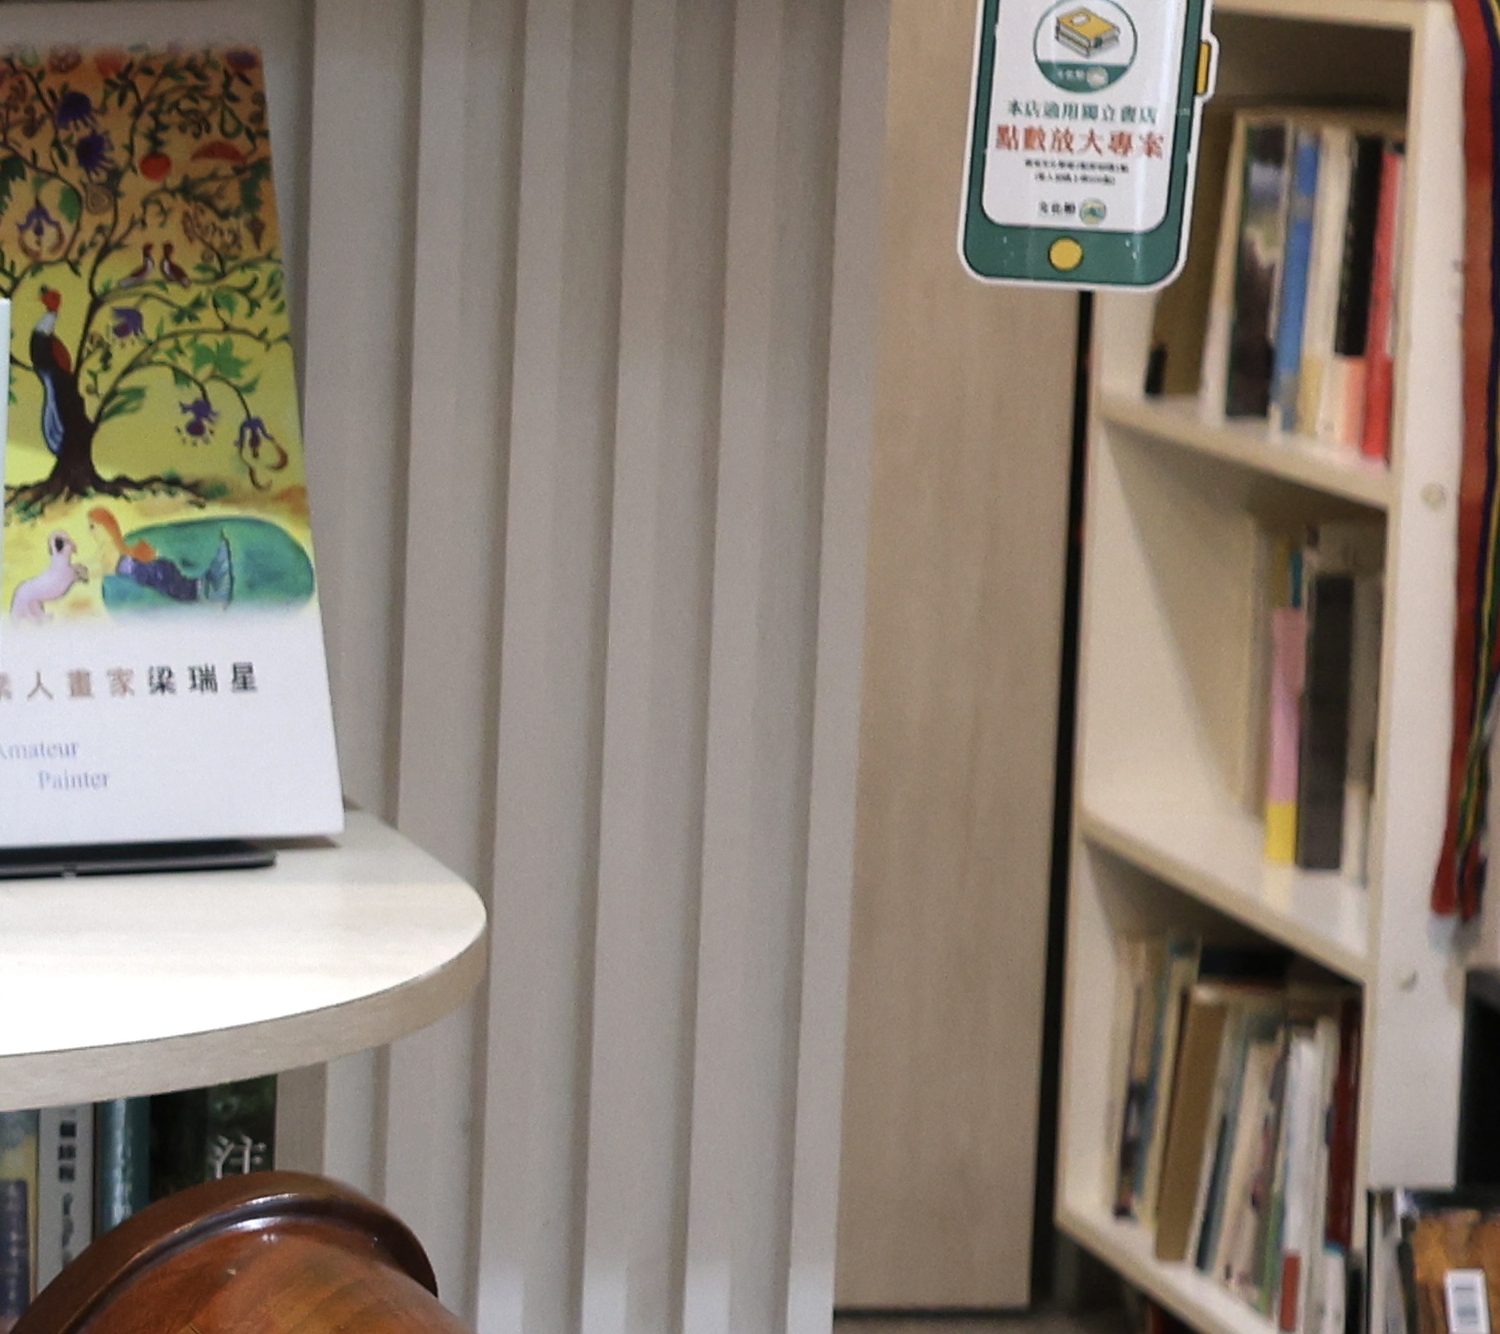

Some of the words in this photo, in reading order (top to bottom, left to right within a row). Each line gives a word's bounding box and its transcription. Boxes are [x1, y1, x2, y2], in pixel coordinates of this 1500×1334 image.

[1007, 99, 1158, 124] 本店適用獨立書店
[996, 125, 1164, 159] 點數放大專案
[38, 770, 109, 790] Painter
